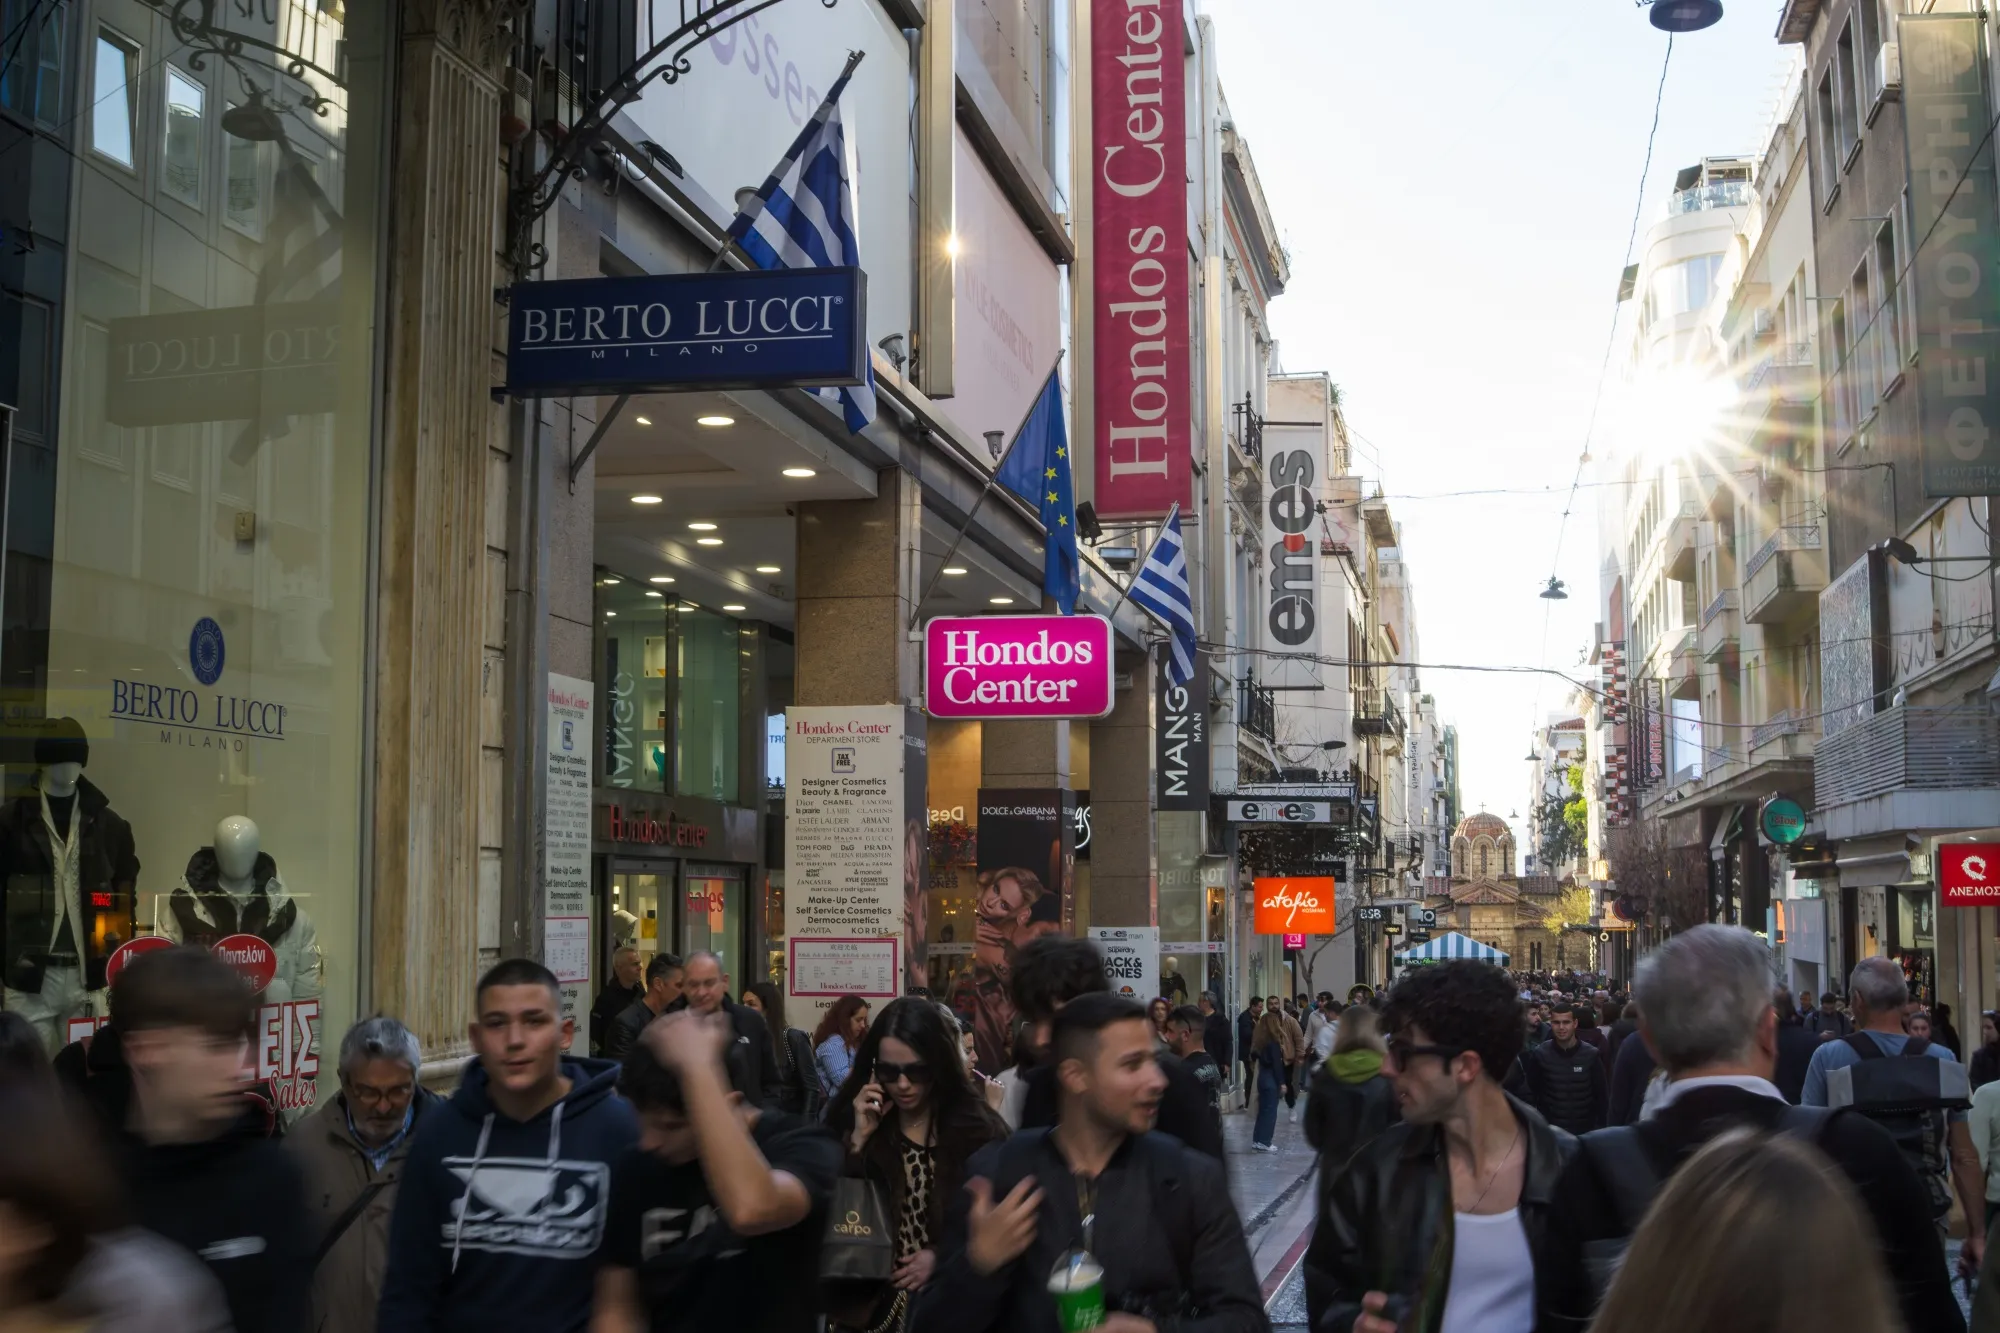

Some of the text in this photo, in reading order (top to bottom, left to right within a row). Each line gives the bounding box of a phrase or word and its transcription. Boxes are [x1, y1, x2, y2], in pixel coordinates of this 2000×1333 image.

[521, 303, 671, 343] BERTO
[591, 343, 758, 359] MILANO
[1109, 225, 1168, 482] Hondos
[943, 629, 1093, 666] Hondos
[943, 666, 1078, 704] Center
[112, 679, 198, 723] BERTO
[796, 721, 891, 734] Hondos Center
[1194, 712, 1202, 742] MAN
[160, 730, 243, 752] MILANO
[806, 736, 855, 744] DEPARTMENT
[802, 777, 887, 788] Designer Cosmetics
[801, 788, 887, 797] Beauty & Fragrance
[610, 804, 710, 848] Hondos Center
[929, 880, 958, 889] ONES
[687, 883, 724, 913] sales
[808, 896, 880, 905] Make-Up Center
[796, 906, 892, 914] Self Service Cosmetics
[807, 916, 880, 924] Dermocosmetics
[851, 927, 889, 935] KORRES
[1100, 930, 1127, 938] ees
[1104, 967, 1143, 979] ONES
[845, 982, 868, 990] Center
[266, 1069, 317, 1114] Sales
[833, 1222, 871, 1236] carpo
